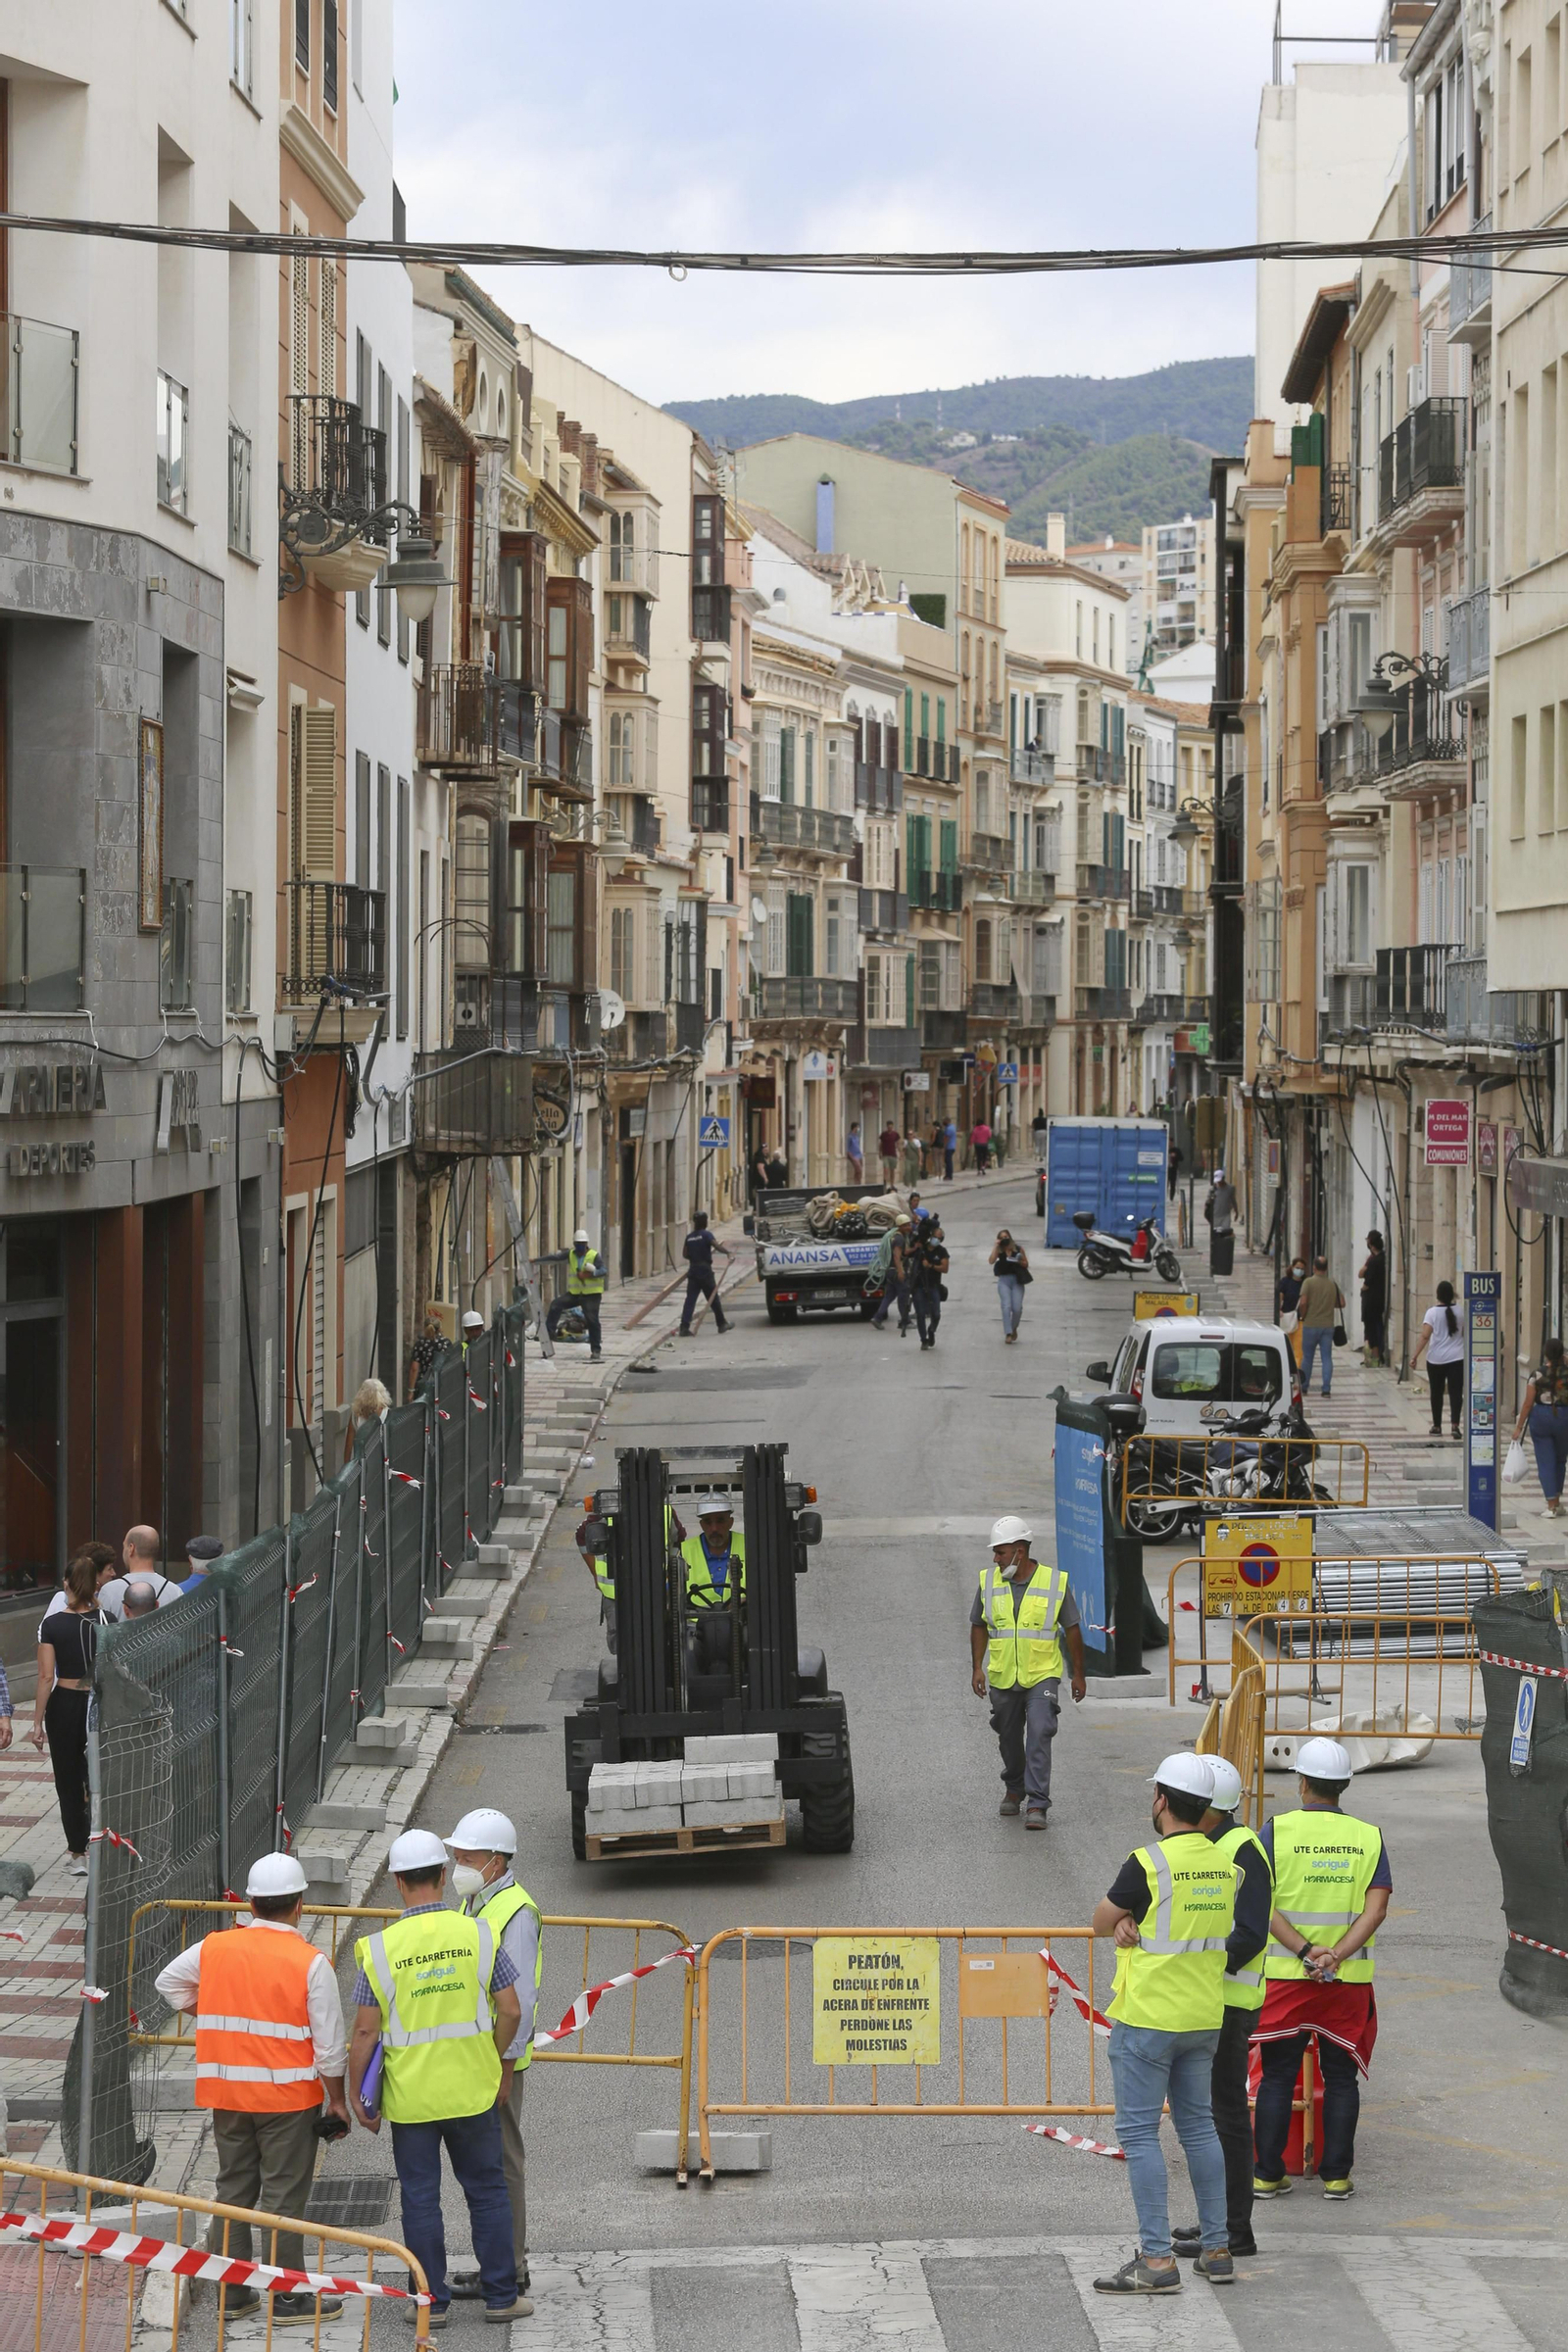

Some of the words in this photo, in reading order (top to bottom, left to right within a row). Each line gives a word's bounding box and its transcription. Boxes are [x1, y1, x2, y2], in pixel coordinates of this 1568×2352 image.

[14, 1141, 96, 1176] DEPORTES
[1428, 1149, 1467, 1161] COMUNIONES
[769, 1250, 841, 1265] ANANSA
[1472, 1278, 1495, 1294] BUS
[1475, 1315, 1491, 1327] 36
[1207, 1592, 1243, 1602] PROHIBDO
[1207, 1604, 1220, 1614] LAS
[1224, 1603, 1230, 1614] 7
[1252, 1603, 1265, 1613] DE
[1174, 1871, 1190, 1881] UTE
[1192, 1869, 1232, 1880] CARRETERÍA
[1184, 1902, 1226, 1912] HORMACESA
[395, 1958, 413, 1970] UTE
[416, 1947, 473, 1965] CARRETERÍA
[848, 1952, 904, 1970] PEATÓN,
[411, 1982, 466, 1998] HORMACESA
[833, 1979, 879, 1991] CIRCULE
[882, 1979, 904, 1990] POR
[907, 1978, 919, 1990] LA
[823, 1999, 858, 2011] ACERA
[861, 1999, 874, 2010] DE
[877, 1999, 929, 2010] ENFRENTE
[840, 2019, 889, 2031] PERDONE
[892, 2019, 912, 2031] LAS
[846, 2039, 907, 2051] MOLESTIAS
